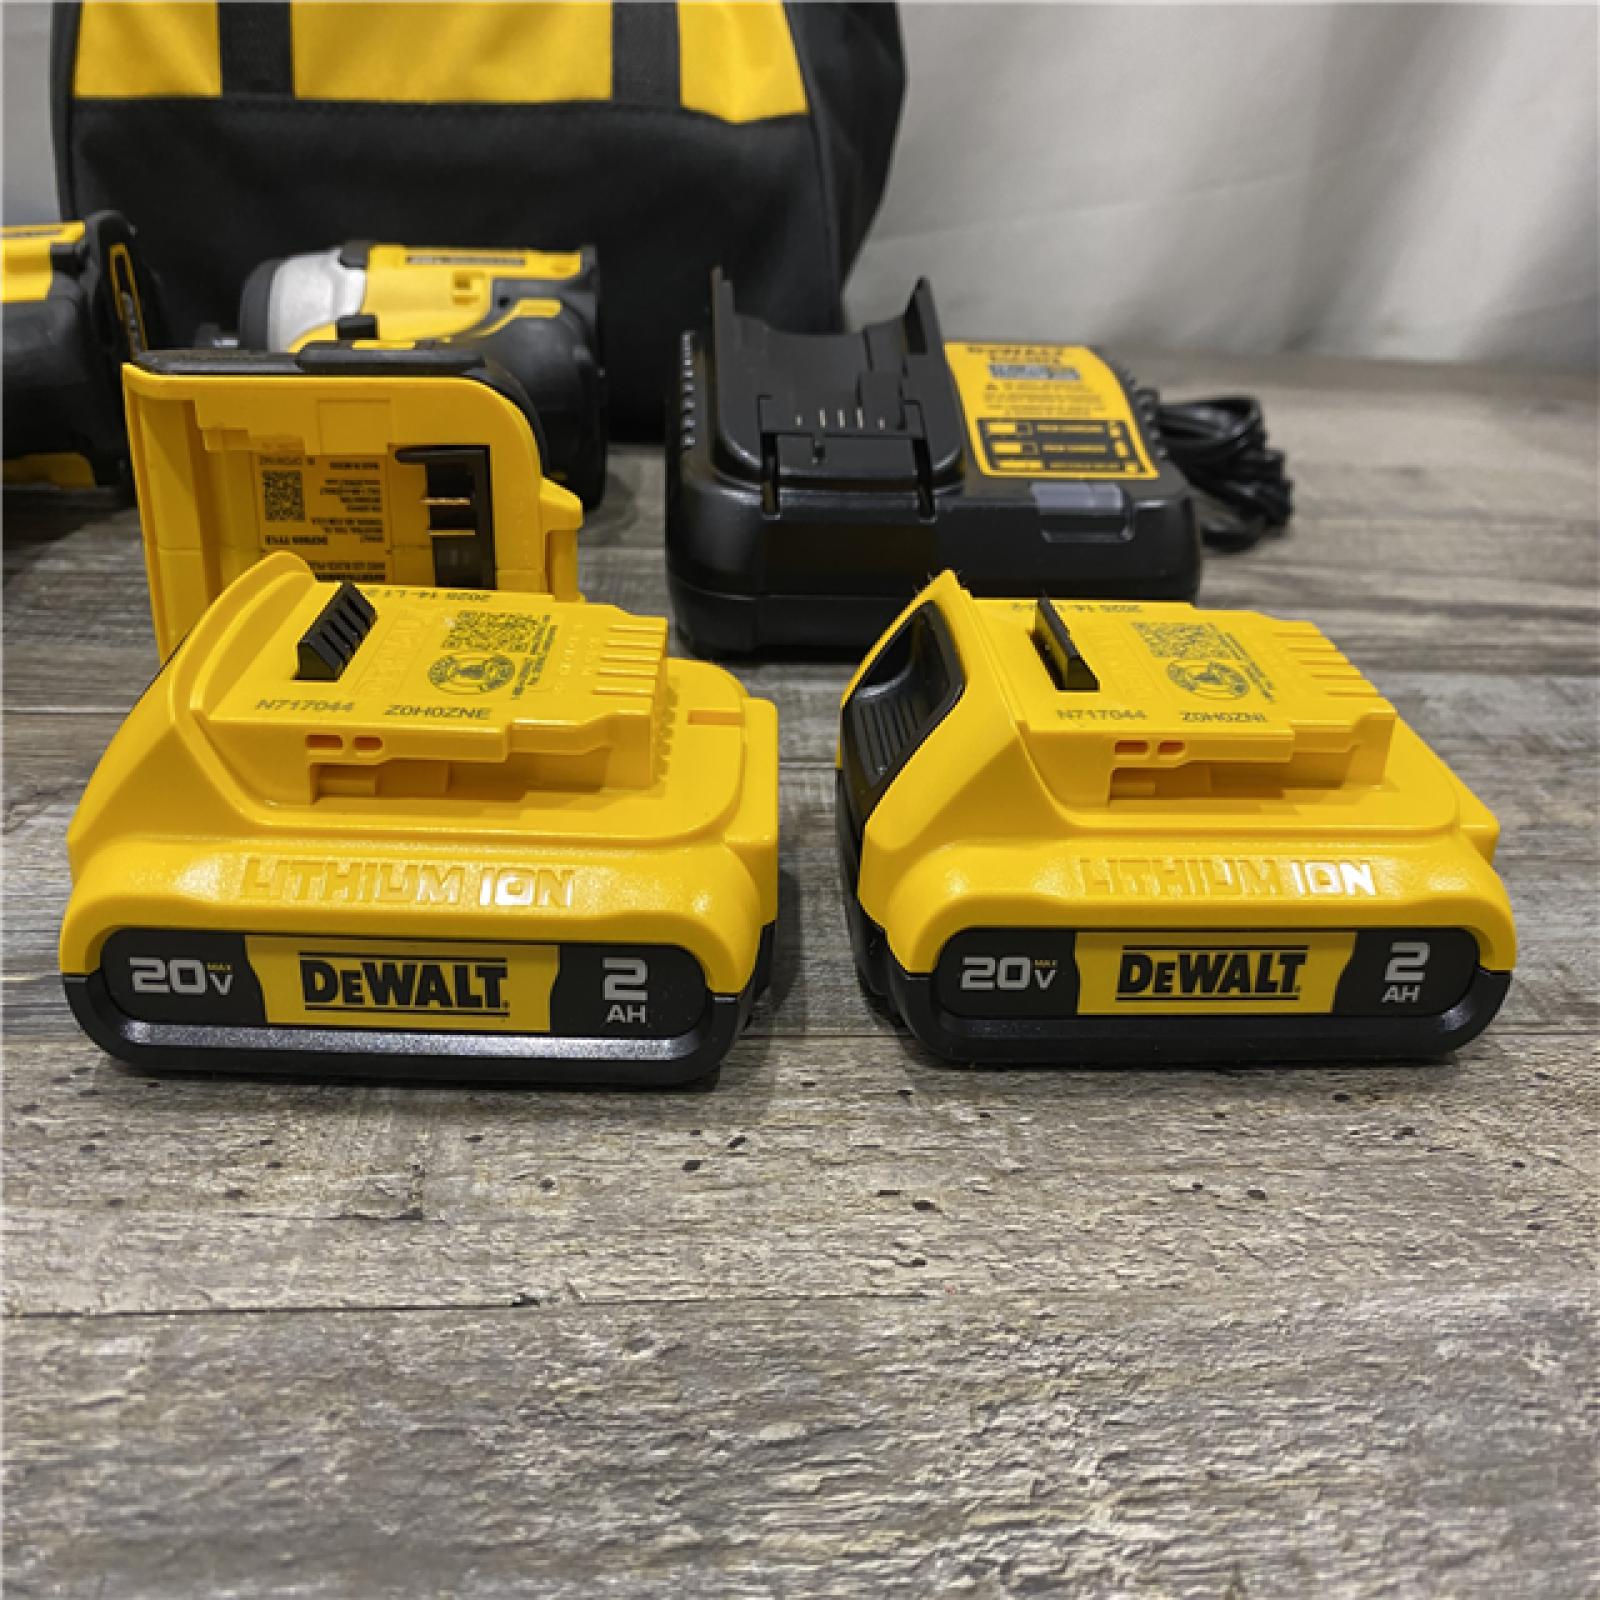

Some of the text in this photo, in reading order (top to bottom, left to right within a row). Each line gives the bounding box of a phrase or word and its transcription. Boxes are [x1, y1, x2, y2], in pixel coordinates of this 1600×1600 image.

[239, 857, 577, 907] LITHIUM ION
[1080, 858, 1378, 897] LITHIUM ION
[603, 956, 649, 1002] 2
[1384, 941, 1431, 982] 2
[607, 1004, 648, 1024] AH
[1381, 984, 1421, 1004] AH
